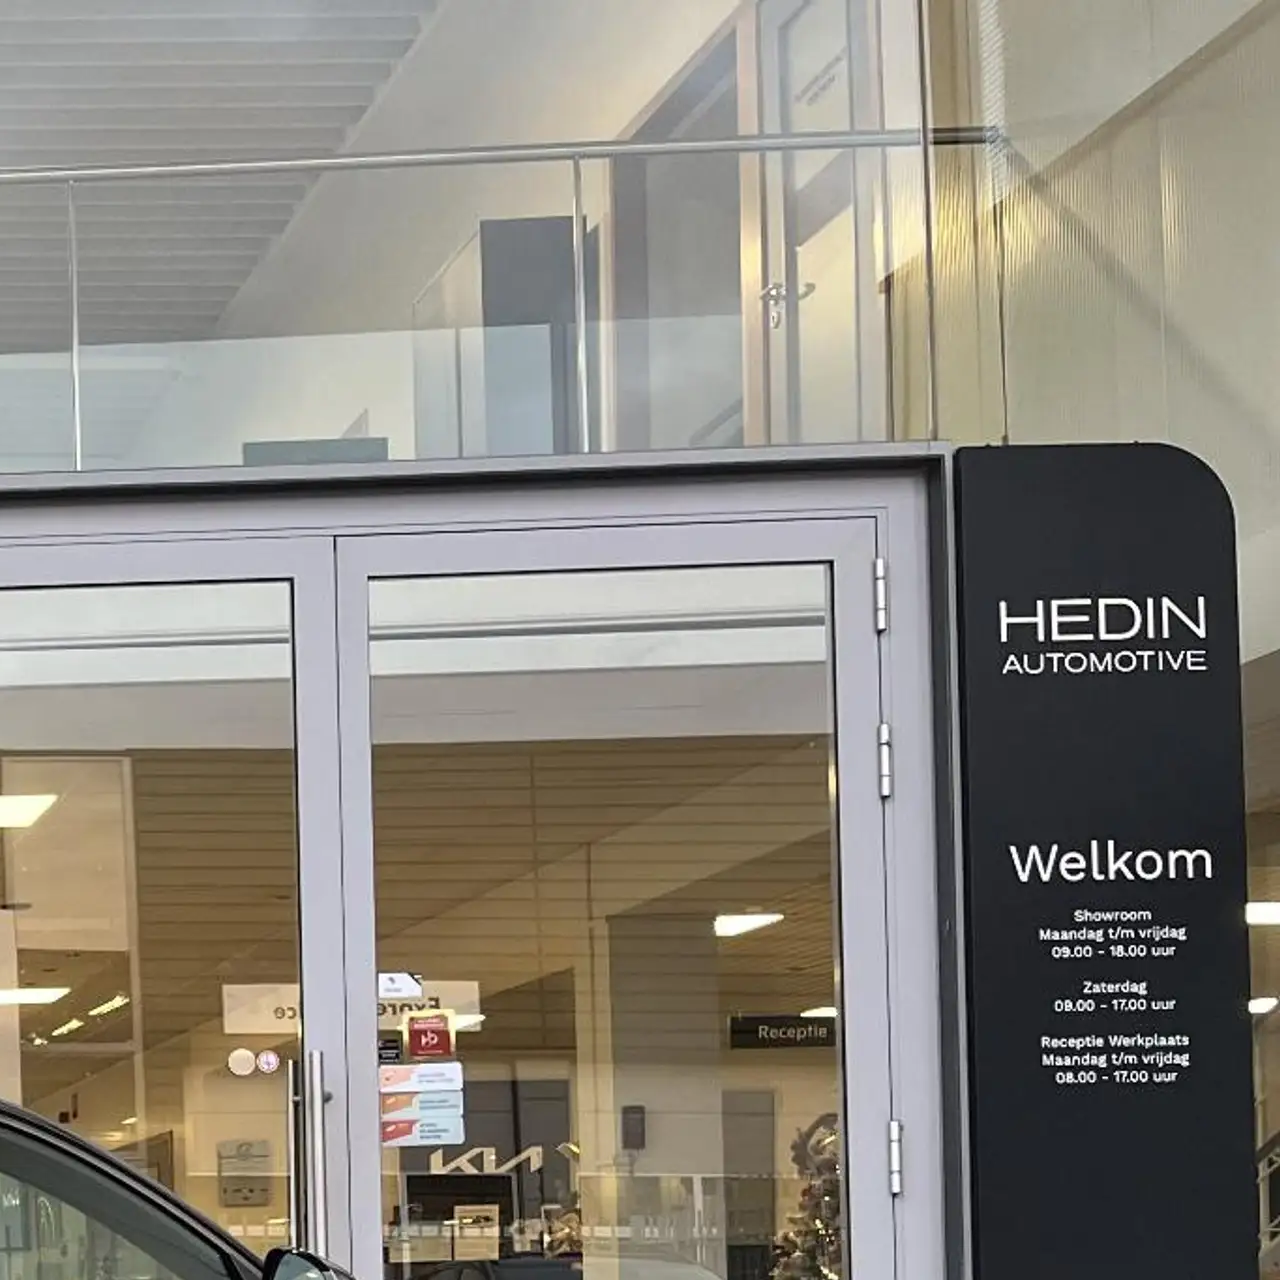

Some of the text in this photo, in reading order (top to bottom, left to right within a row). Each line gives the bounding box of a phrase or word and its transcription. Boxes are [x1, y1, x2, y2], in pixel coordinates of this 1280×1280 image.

[998, 596, 1207, 643] HEDIN
[1002, 650, 1208, 675] AUTOMOTIVE
[1009, 839, 1212, 883] Welkom
[1073, 909, 1152, 922] Showroom
[1039, 925, 1187, 943] Maandag t/m vrijdag
[1051, 945, 1093, 959] 09.00
[1109, 944, 1147, 958] 18.00
[1151, 946, 1176, 957] uur
[1082, 979, 1148, 996] Zaterdag
[1111, 998, 1147, 1011] 17.00
[1150, 999, 1177, 1010] uur
[758, 1024, 828, 1041] Receptie
[1040, 1033, 1190, 1051] Receptie Werkplaats
[1042, 1051, 1190, 1068] Maandag t/m vrijdag
[1055, 1070, 1097, 1084] 08.00
[1113, 1070, 1149, 1083] 17.00
[1152, 1072, 1178, 1083] uur
